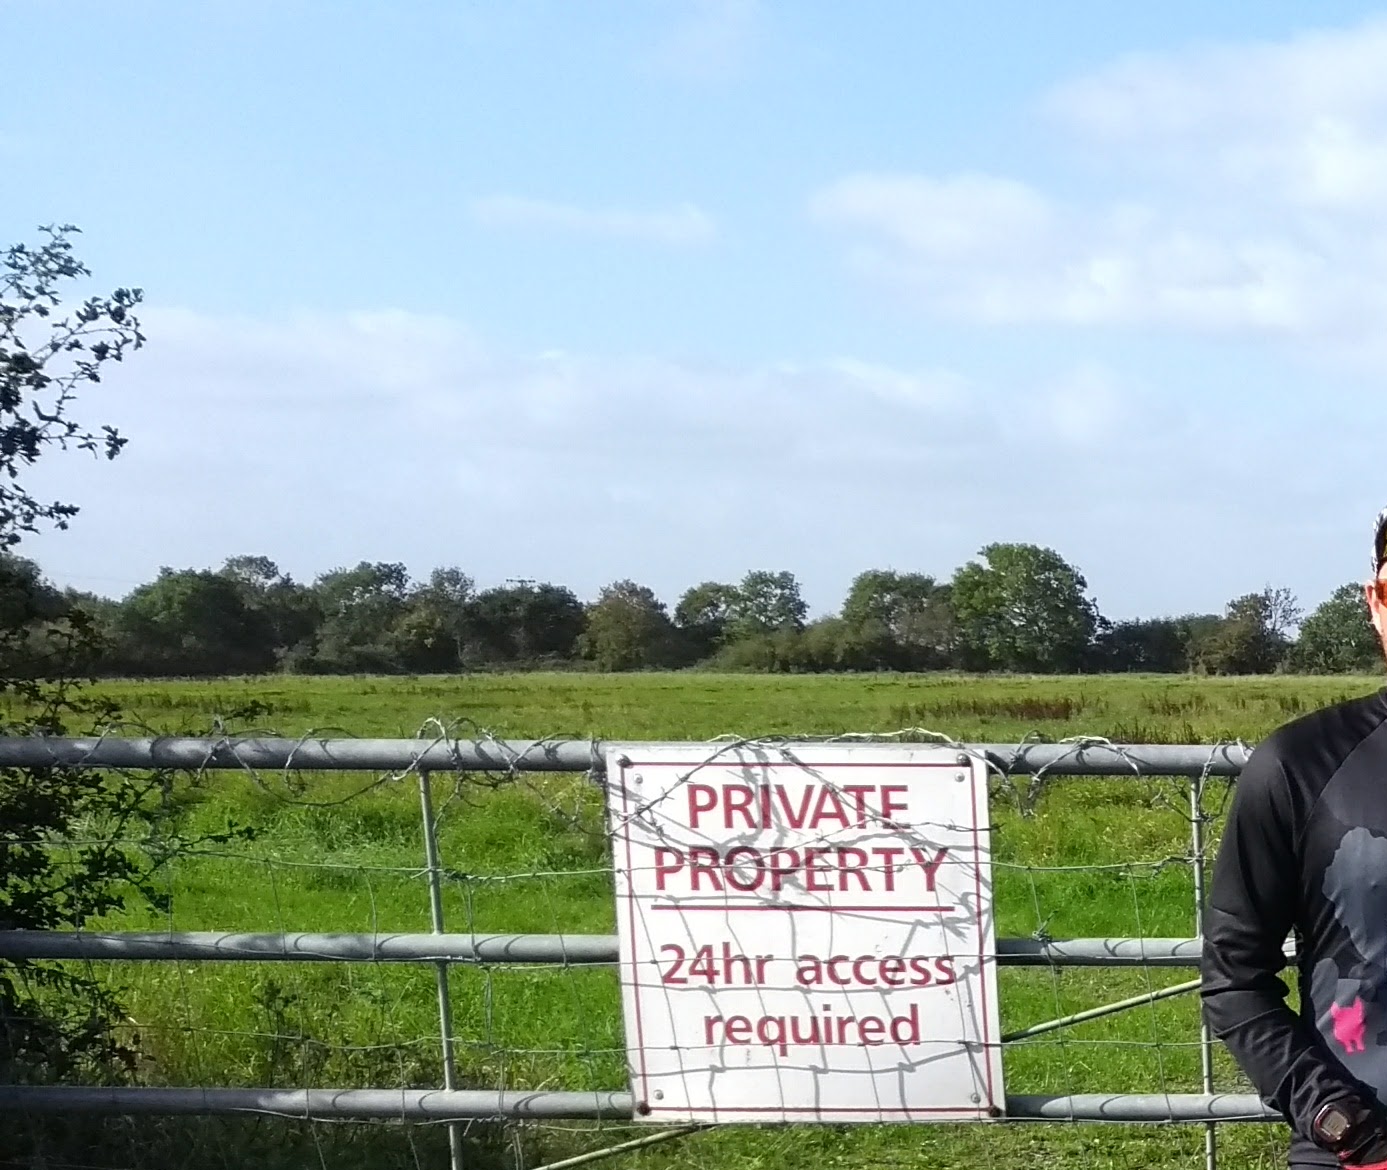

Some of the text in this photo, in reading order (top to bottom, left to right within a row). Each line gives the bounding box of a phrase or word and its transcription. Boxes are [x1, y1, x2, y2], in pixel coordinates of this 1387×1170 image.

[687, 784, 908, 829] PRIVATE
[654, 846, 950, 892] PROPERTY
[660, 942, 956, 986] 24hr access
[704, 1004, 921, 1057] required
